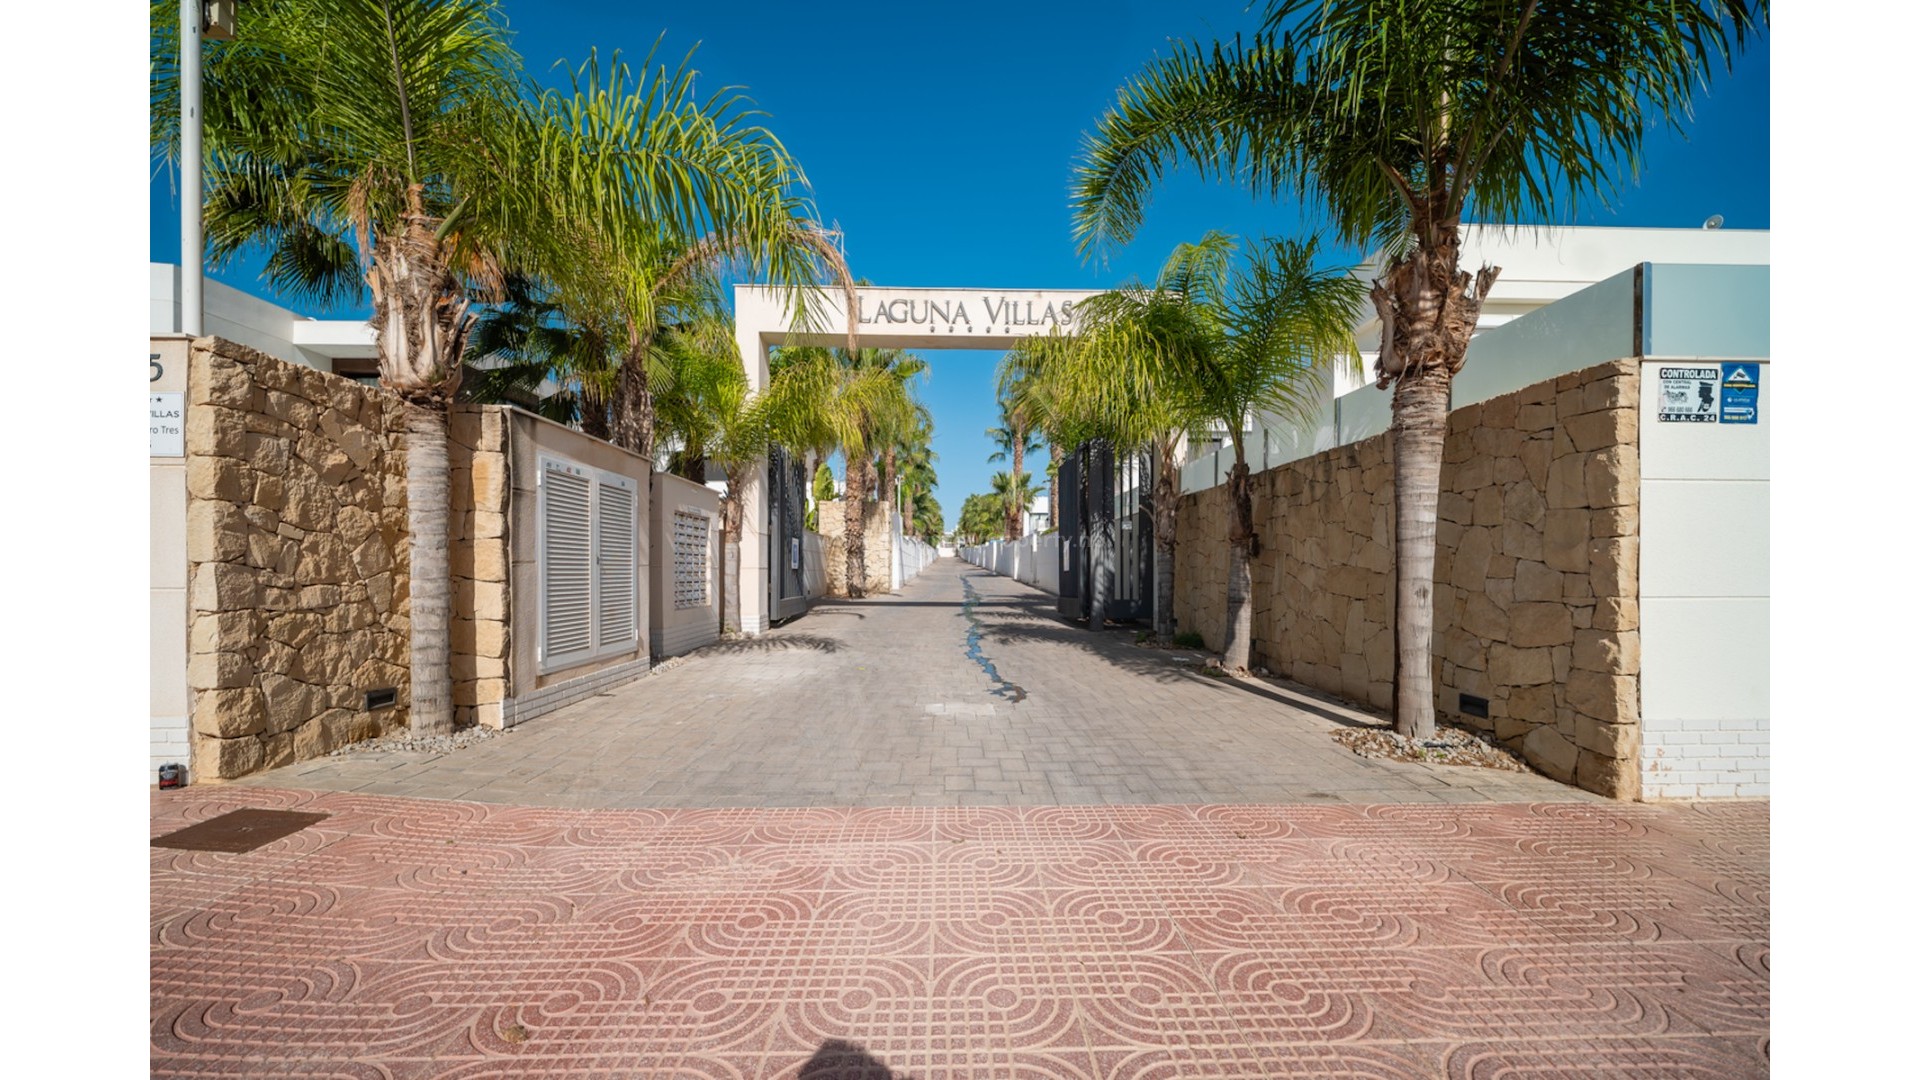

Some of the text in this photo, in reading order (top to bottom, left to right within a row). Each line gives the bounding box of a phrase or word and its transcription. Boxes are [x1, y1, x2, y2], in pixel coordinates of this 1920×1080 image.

[857, 296, 1074, 326] LAGUNA VILLAS
[1661, 369, 1717, 379] CONTROLADA
[161, 426, 179, 434] Tres
